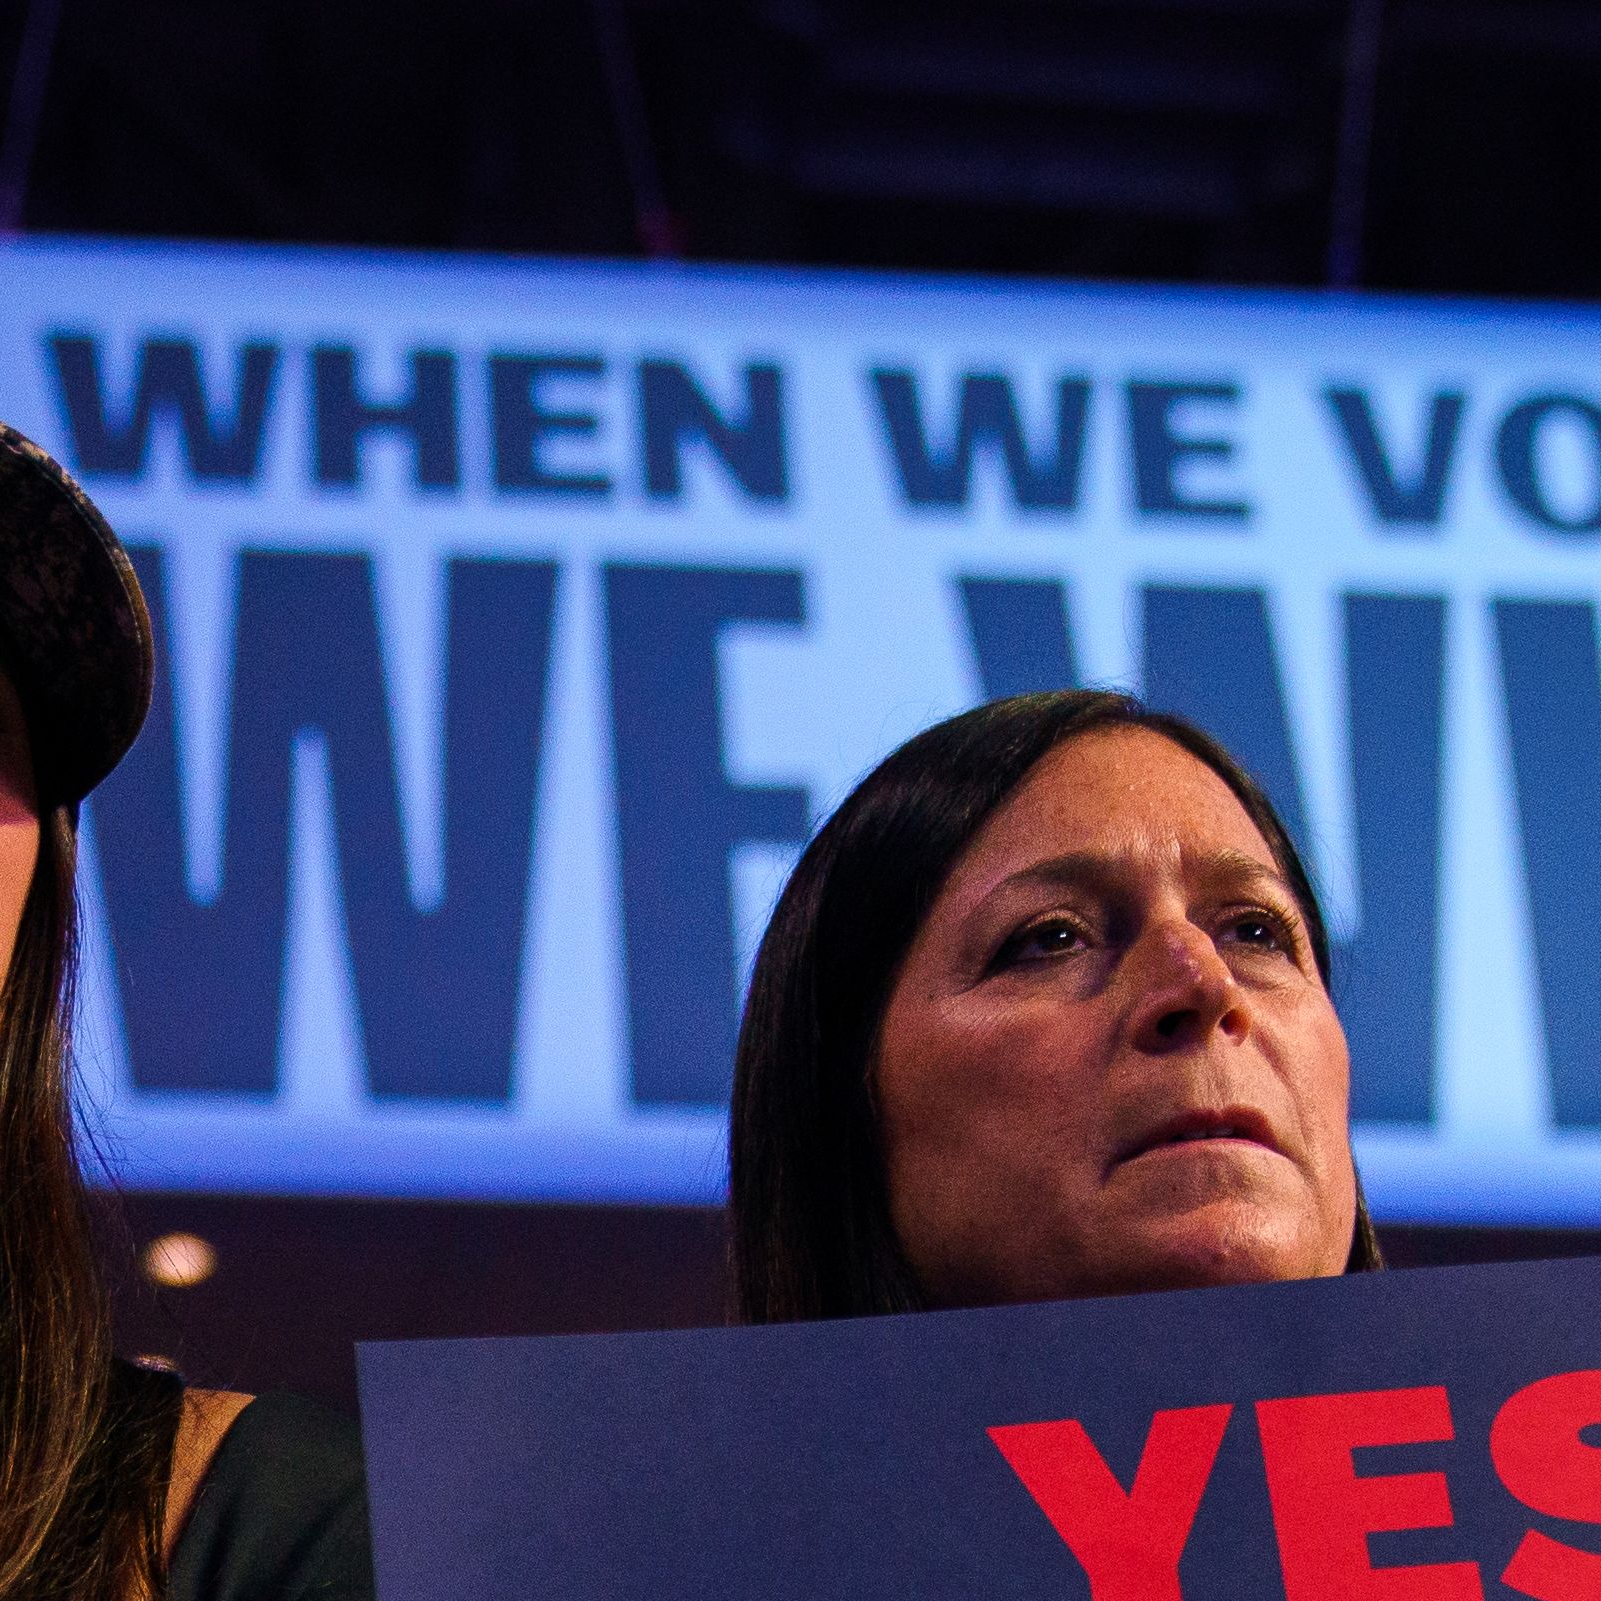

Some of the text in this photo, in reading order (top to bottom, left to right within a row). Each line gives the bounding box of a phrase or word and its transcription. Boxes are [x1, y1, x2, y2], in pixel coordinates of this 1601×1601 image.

[45, 328, 791, 505] WHEN
[867, 367, 1257, 524] WE
[85, 542, 813, 1107] WE
